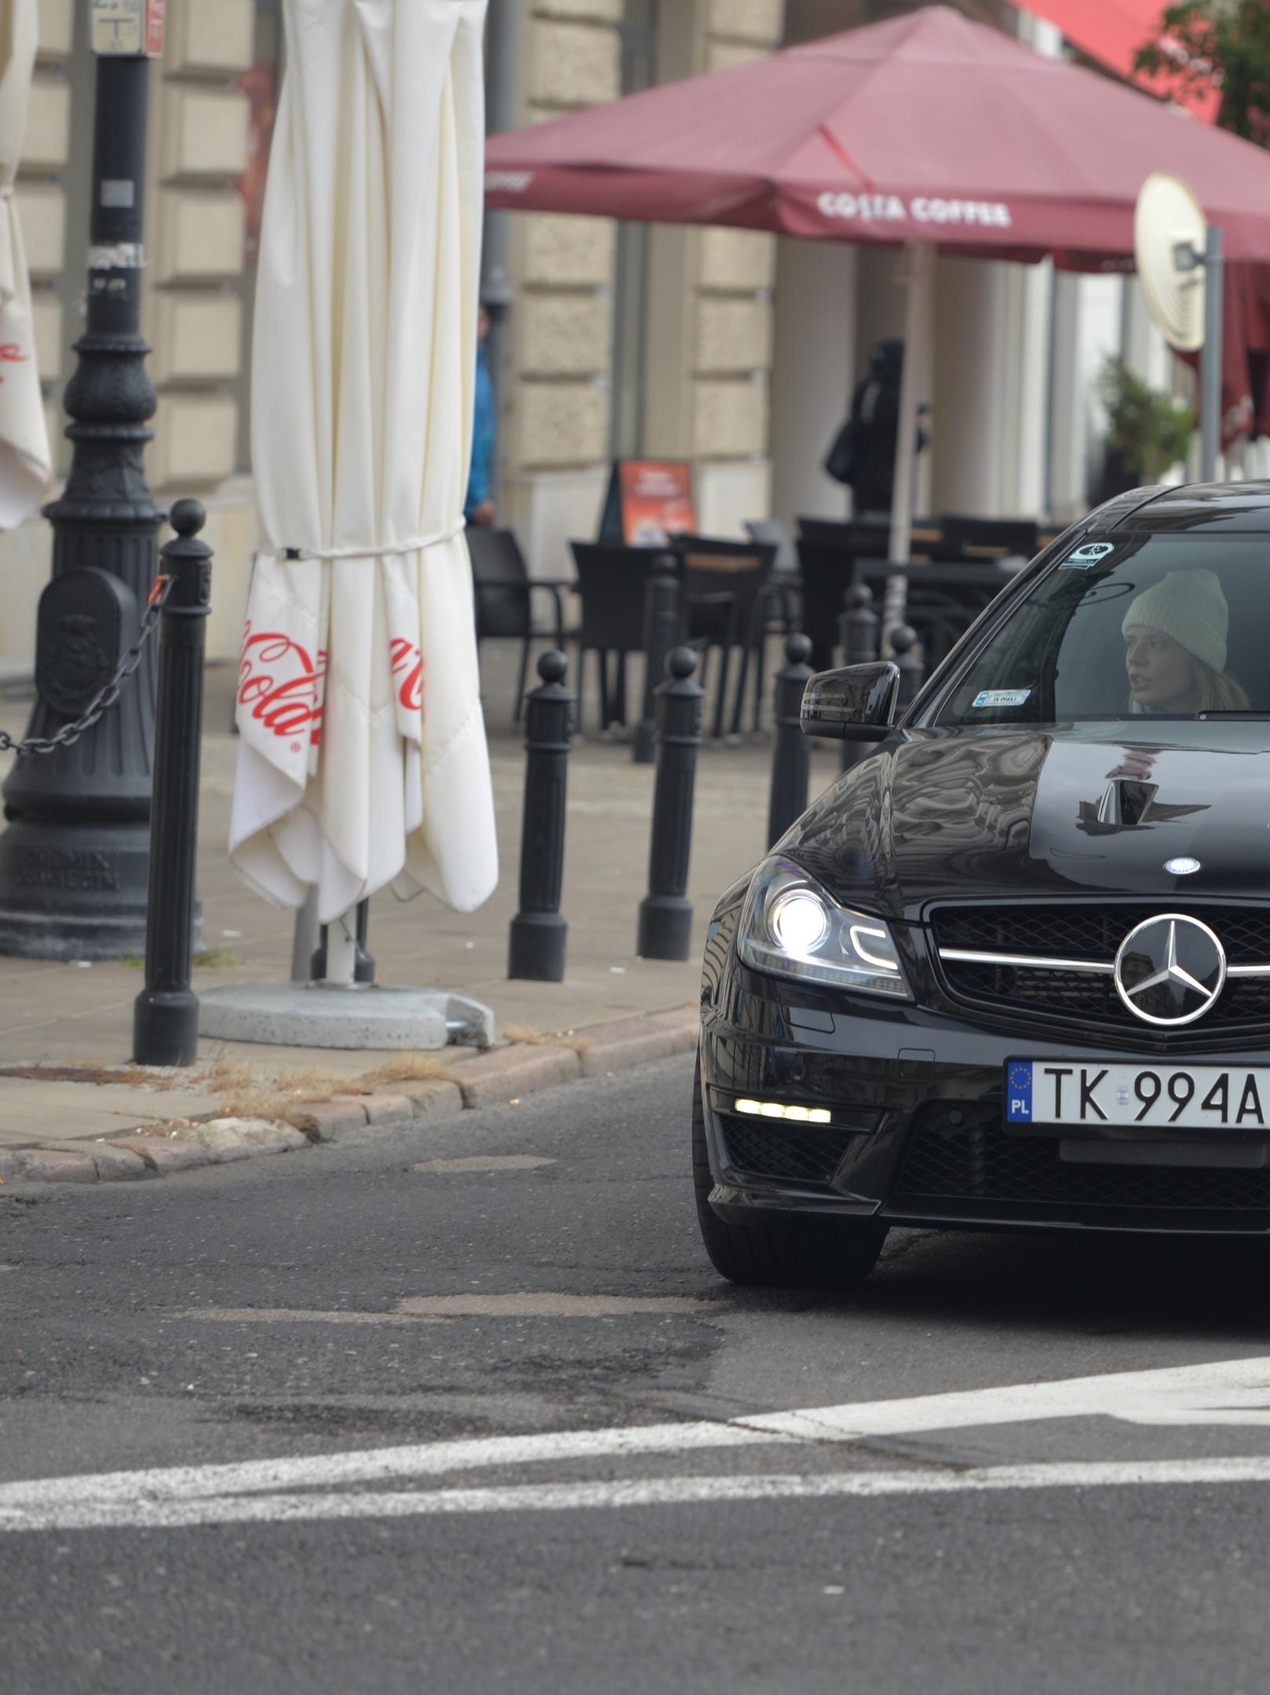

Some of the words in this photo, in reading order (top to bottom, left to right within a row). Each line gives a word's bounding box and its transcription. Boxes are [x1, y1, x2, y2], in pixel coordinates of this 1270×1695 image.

[910, 196, 1012, 228] COFFEE
[1011, 1100, 1029, 1114] PL
[1045, 1068, 1109, 1120] TK
